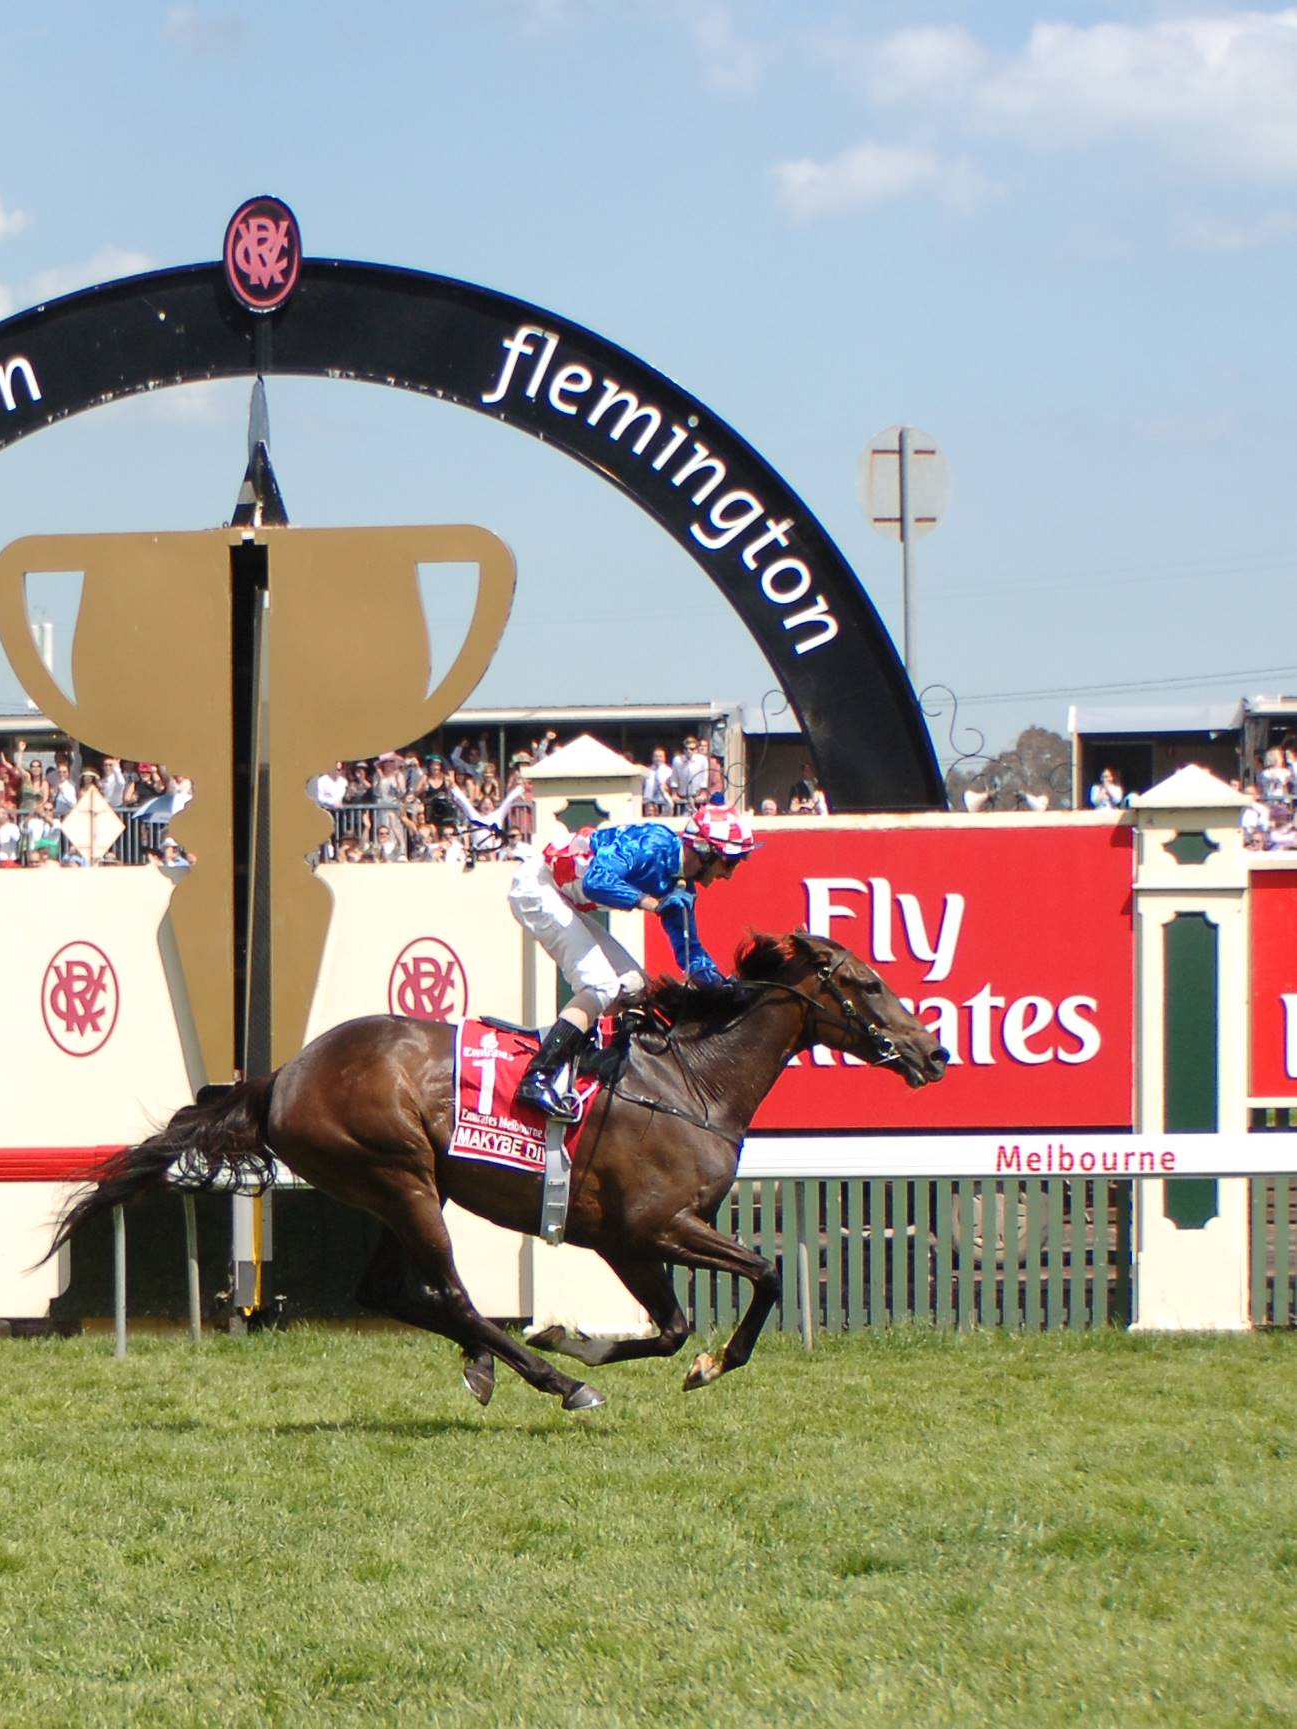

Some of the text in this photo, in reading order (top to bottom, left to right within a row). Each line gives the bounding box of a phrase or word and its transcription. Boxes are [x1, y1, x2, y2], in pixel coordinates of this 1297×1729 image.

[482, 325, 839, 655] flemington
[804, 877, 965, 982] Fly
[472, 1058, 496, 1115] 1
[457, 1127, 522, 1156] MAKYBE
[996, 1145, 1176, 1172] Melbourne
